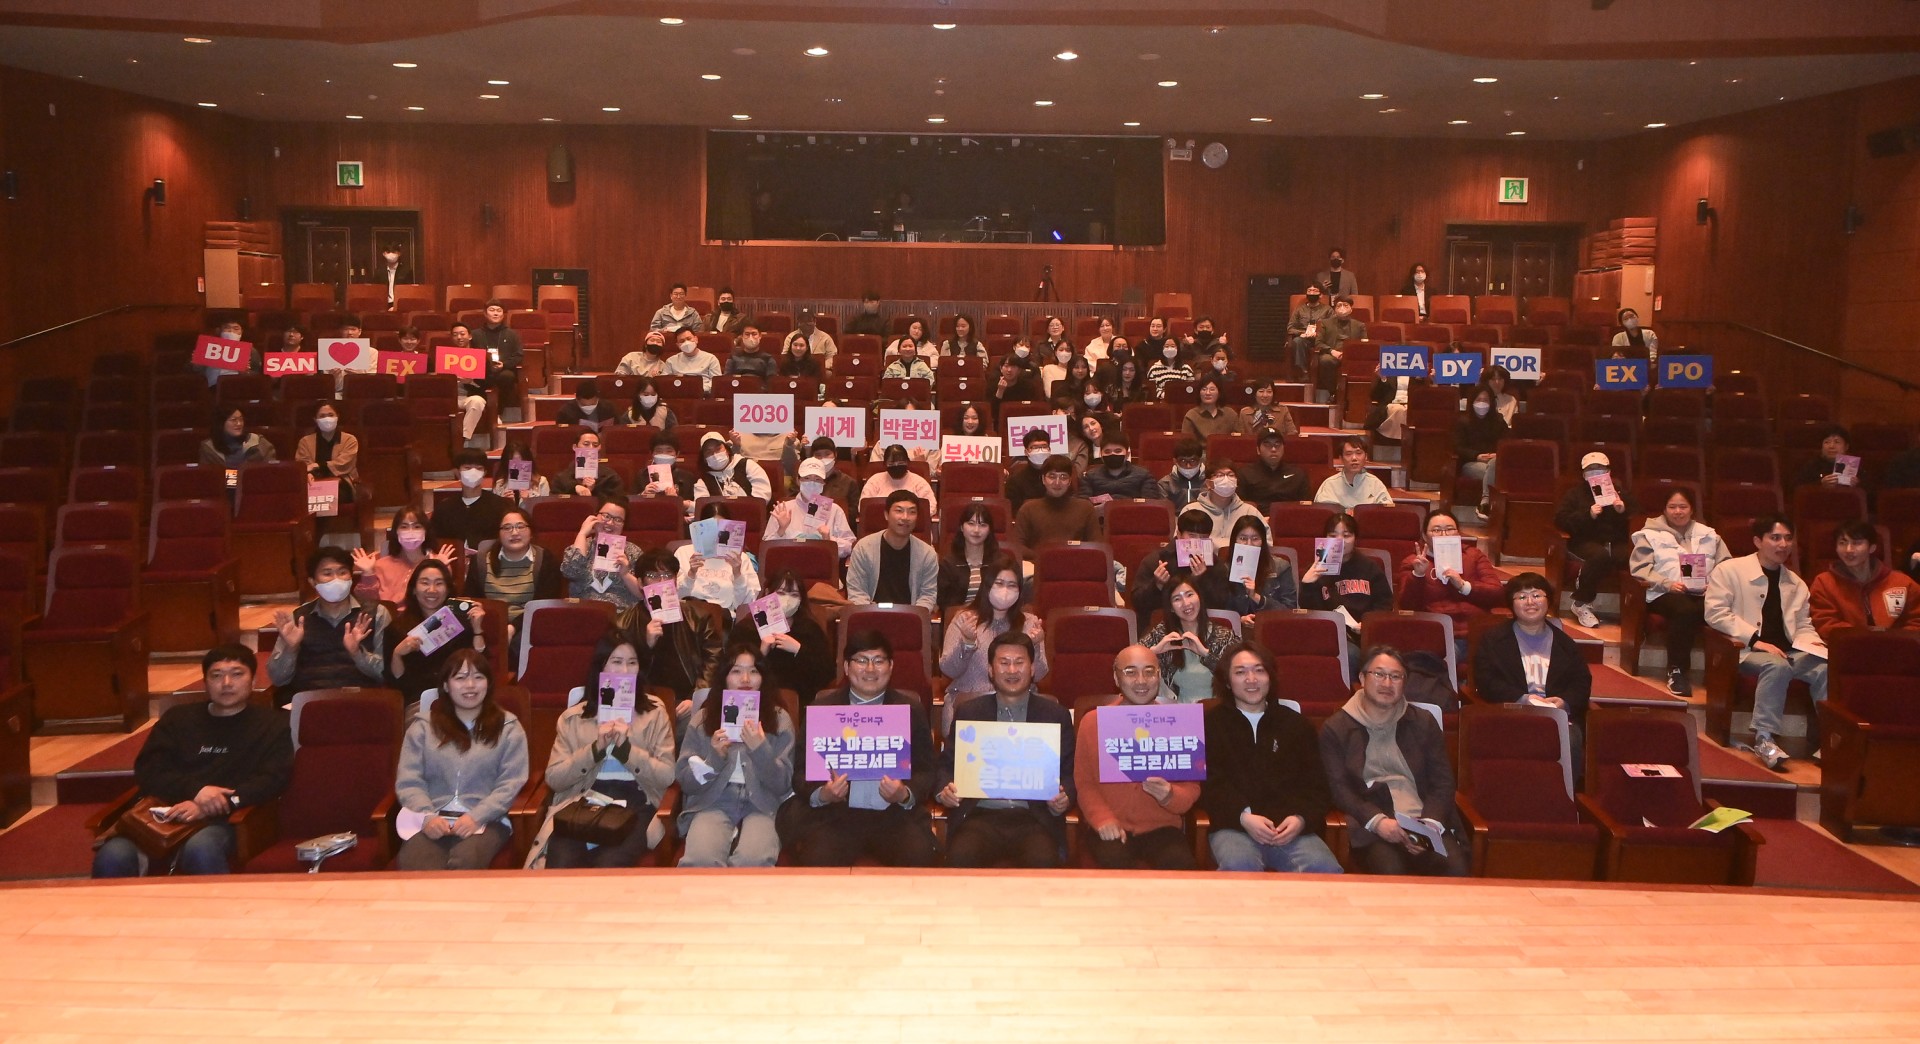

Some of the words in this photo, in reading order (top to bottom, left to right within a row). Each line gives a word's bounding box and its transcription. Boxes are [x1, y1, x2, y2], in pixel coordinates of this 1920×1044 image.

[205, 343, 240, 363] BU
[1381, 352, 1425, 370] REA
[266, 358, 315, 372] SAN
[386, 359, 417, 376] EX
[444, 354, 477, 371] PO
[1442, 360, 1473, 377] DY
[1494, 355, 1537, 372] FOR
[1668, 362, 1703, 380] PO
[1605, 365, 1638, 383] EX
[739, 404, 789, 423] 2030
[815, 416, 855, 438] 세계
[883, 418, 937, 440] 박람회
[945, 443, 999, 463] 부산이
[812, 736, 841, 752] 청년
[846, 735, 905, 751] 마음토닥
[1105, 737, 1134, 753] 청년
[1139, 735, 1199, 752] 마음토닥
[825, 753, 897, 769] 토크콘서트
[1118, 754, 1192, 770] 토크콘서트
